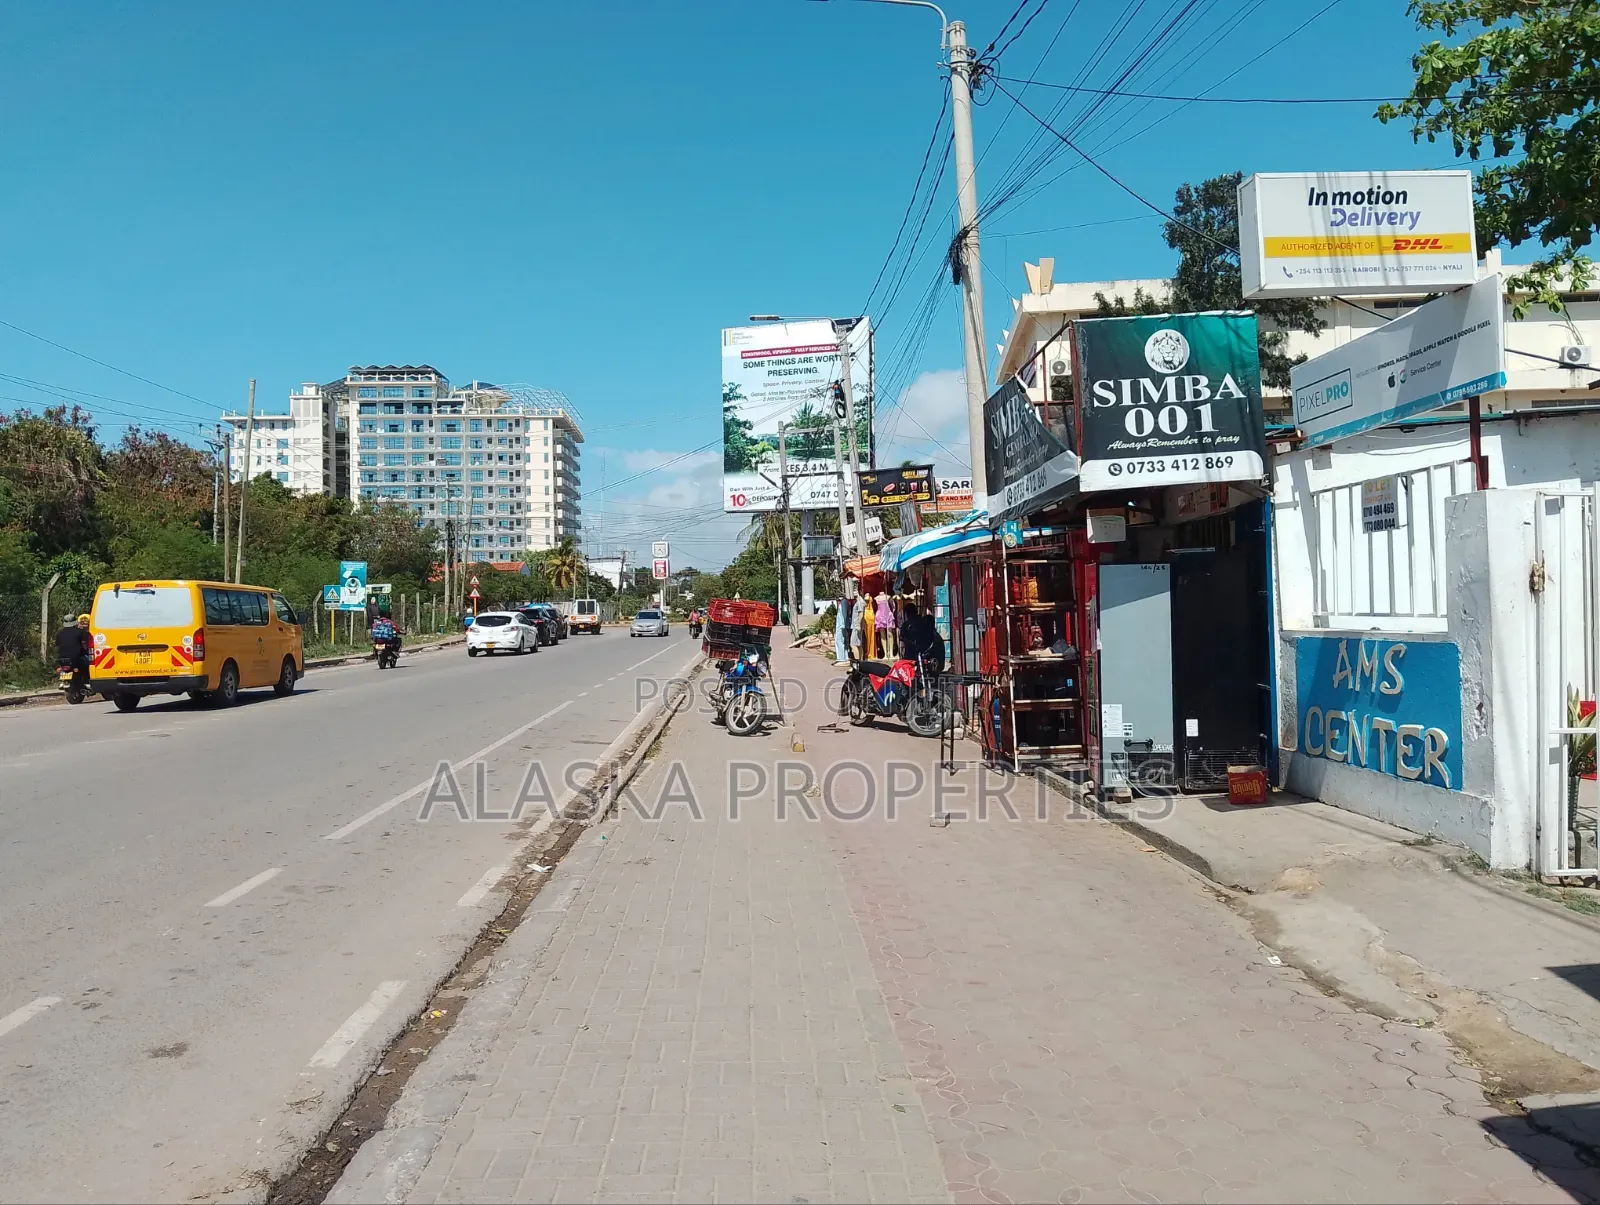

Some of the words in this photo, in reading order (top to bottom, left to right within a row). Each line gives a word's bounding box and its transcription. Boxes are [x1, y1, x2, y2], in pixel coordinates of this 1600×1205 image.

[1330, 207, 1421, 231] Delivery
[1281, 242, 1333, 251] AUTHORIZED
[1335, 242, 1361, 250] AGENT
[1364, 241, 1375, 249] OF
[1392, 238, 1443, 250] DHL
[1423, 343, 1437, 353] APPLE
[1437, 335, 1453, 347] WATCH
[1458, 326, 1477, 339] GOOGLE
[1477, 319, 1491, 330] PIXEL
[743, 361, 765, 369] SOME
[767, 358, 796, 367] THINGS
[767, 367, 819, 377] PRESERVING.
[1409, 366, 1426, 377] Service
[1427, 359, 1442, 371] Center
[1093, 372, 1247, 408] SIMBA
[1124, 403, 1219, 437] 001
[1202, 436, 1212, 444] to
[1215, 435, 1240, 447] pray
[1126, 457, 1165, 474] 0733
[1171, 456, 1200, 471] 412
[1205, 455, 1234, 470] 869
[1333, 639, 1408, 695] AMS
[1304, 706, 1453, 789] CENTER
